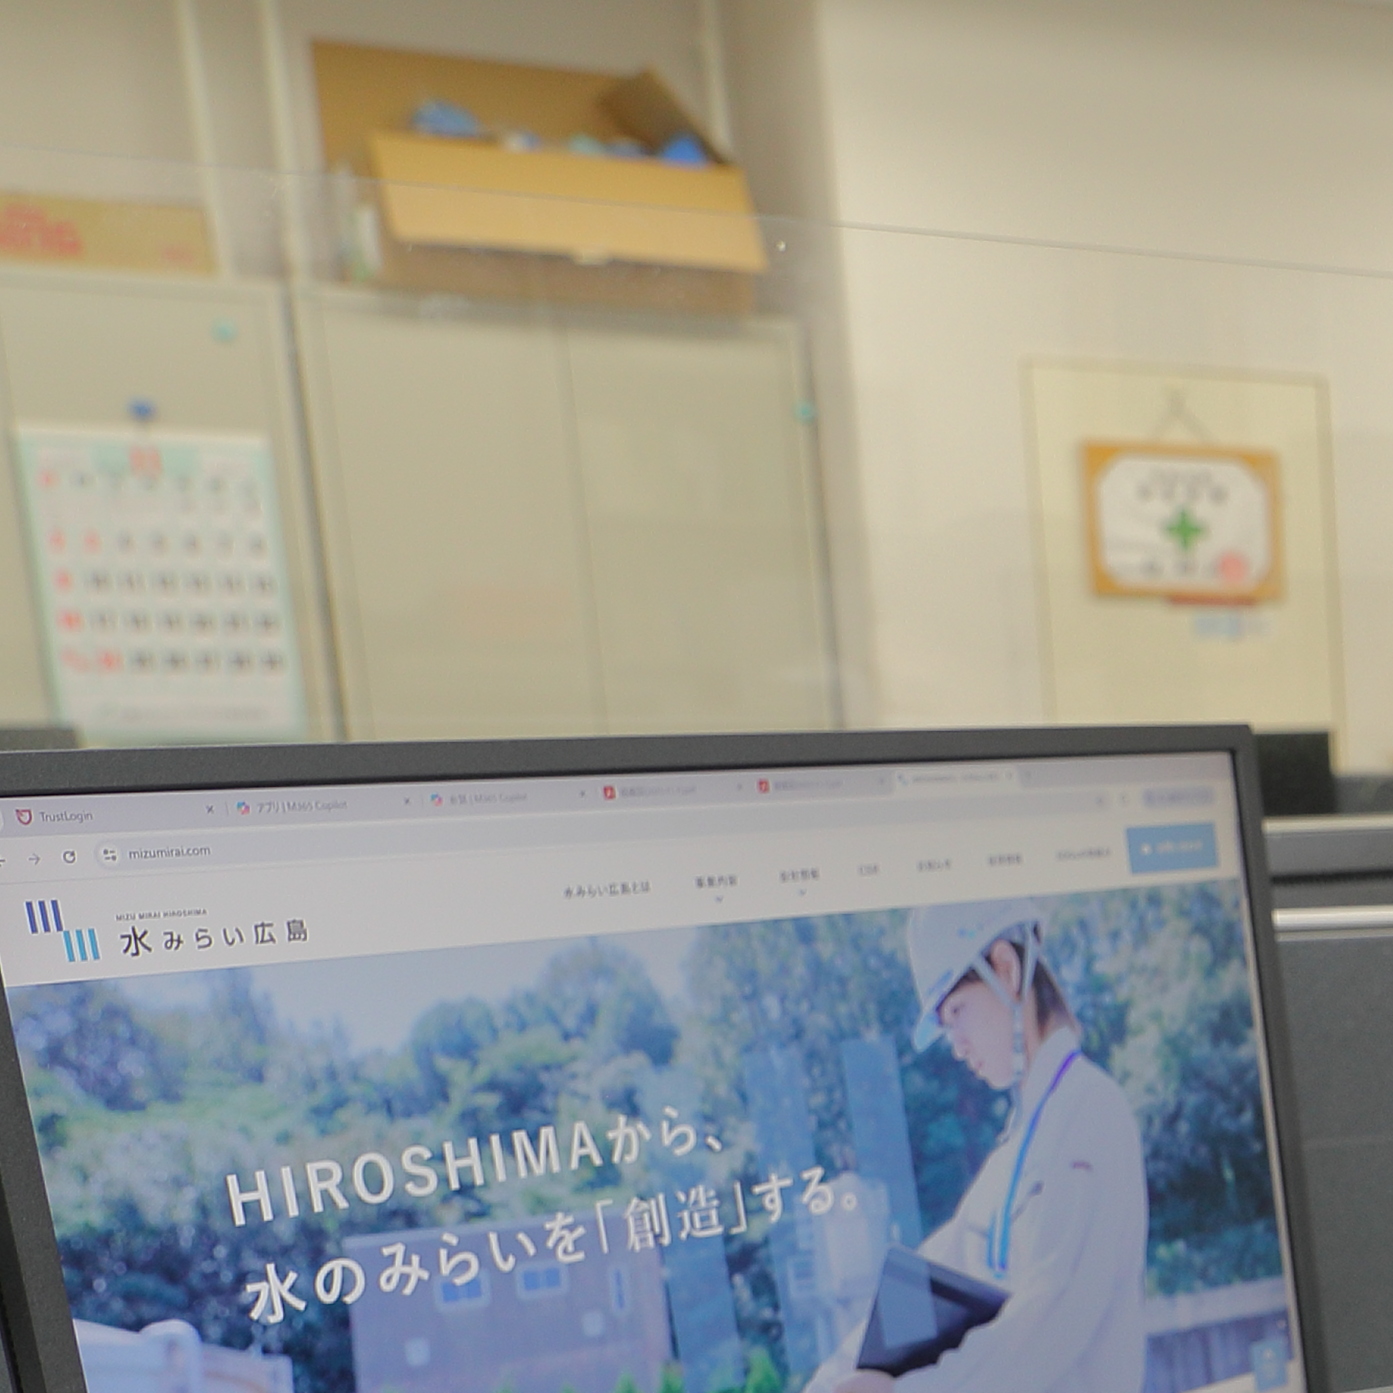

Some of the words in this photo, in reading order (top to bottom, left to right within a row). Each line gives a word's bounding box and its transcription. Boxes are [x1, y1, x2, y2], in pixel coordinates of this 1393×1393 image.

[39, 811, 93, 824] TrustLogin
[129, 845, 211, 860] mizumirai.com
[115, 912, 136, 921] MIZU
[138, 911, 160, 920] MIRAI
[163, 908, 207, 918] HIROSHIMA
[119, 919, 308, 957] 水みらい広島
[226, 1104, 723, 1227] HIROSHIMAから、
[244, 1164, 858, 1326] 水のみらいを「創造」する。
